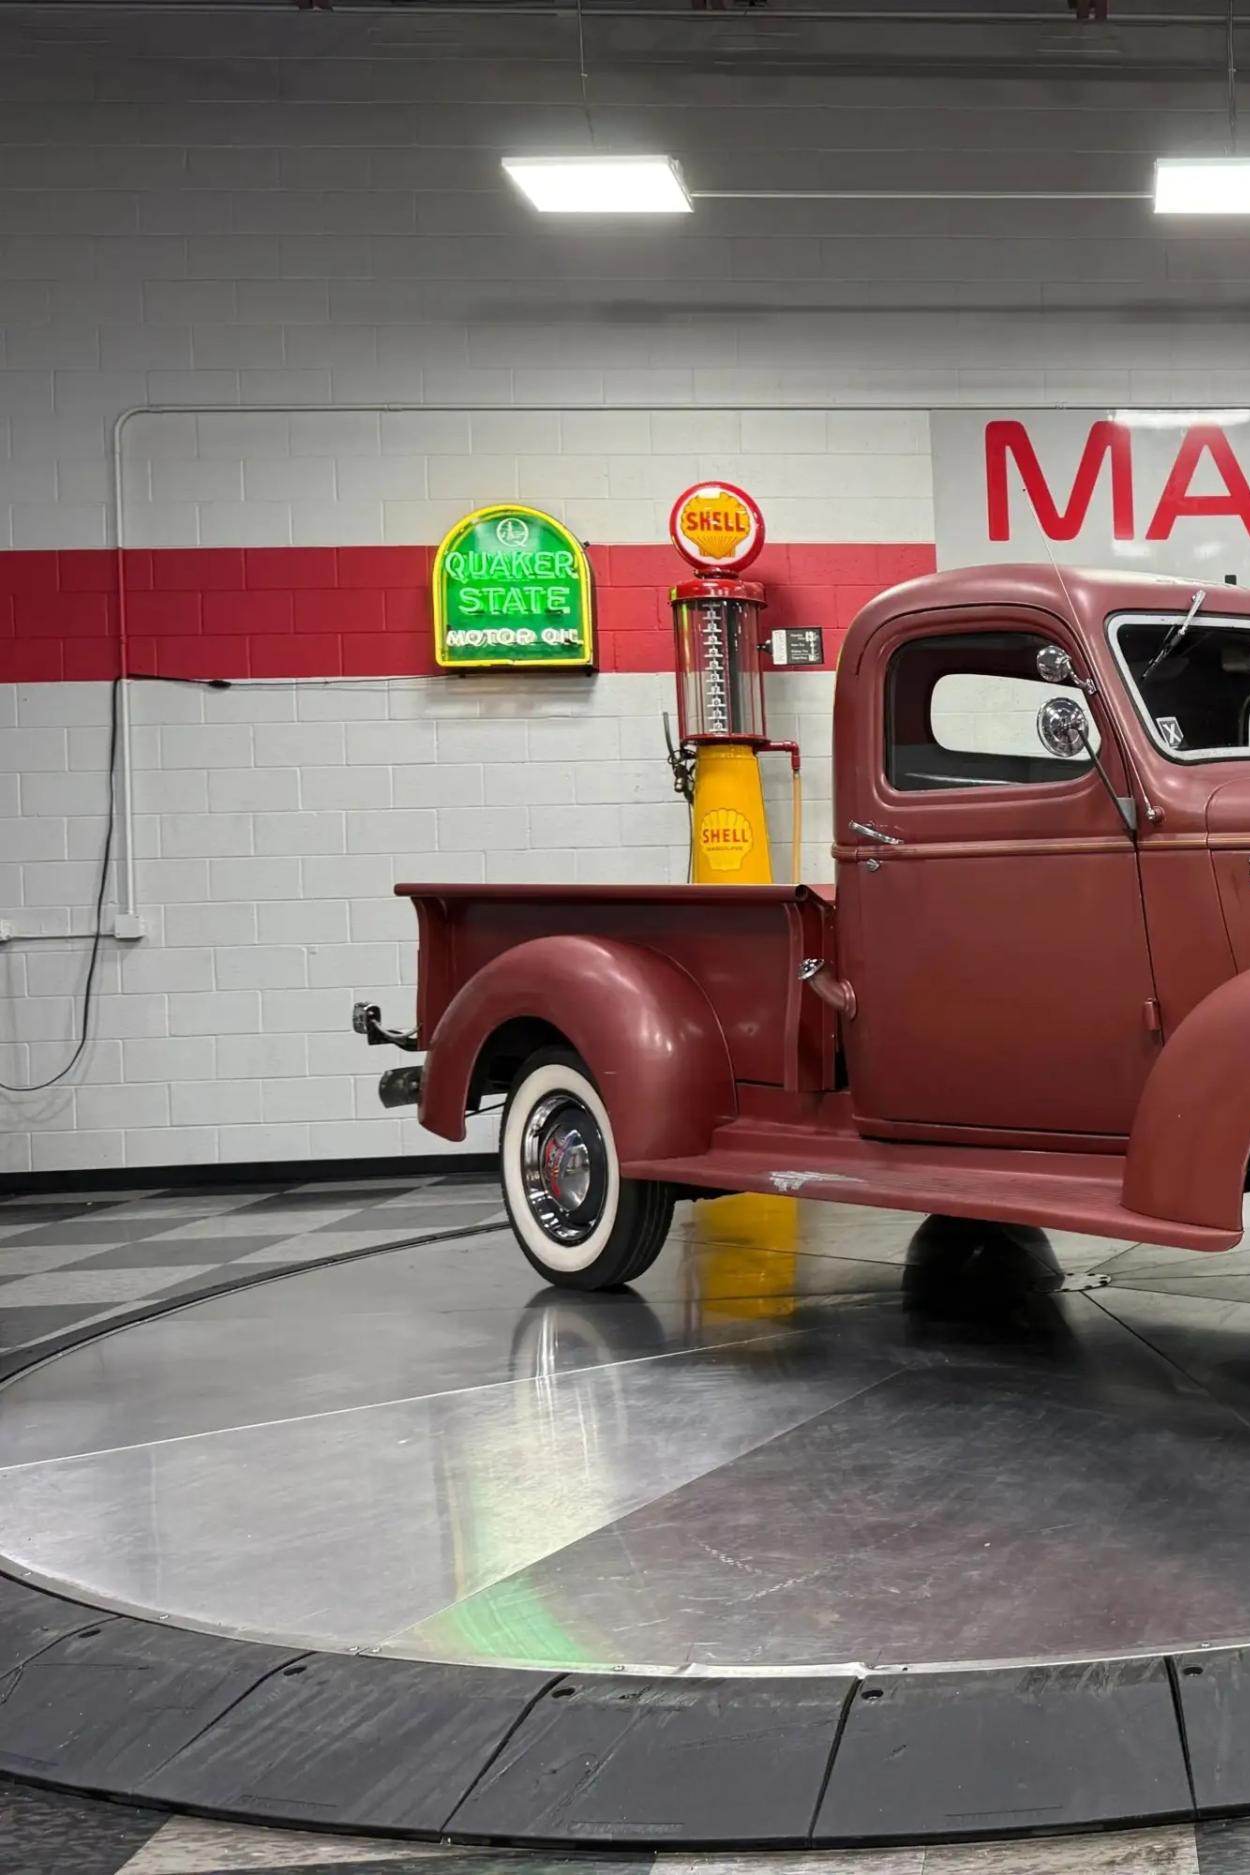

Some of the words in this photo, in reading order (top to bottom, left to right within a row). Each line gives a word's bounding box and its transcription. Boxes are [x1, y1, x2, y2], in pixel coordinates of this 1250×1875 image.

[685, 511, 746, 532] SHELL
[445, 550, 578, 584] QUAKER
[458, 586, 571, 615] STATE
[446, 627, 537, 647] MOTOR
[541, 627, 584, 646] OIL
[1162, 723, 1182, 744] X
[703, 829, 749, 843] SHELL
